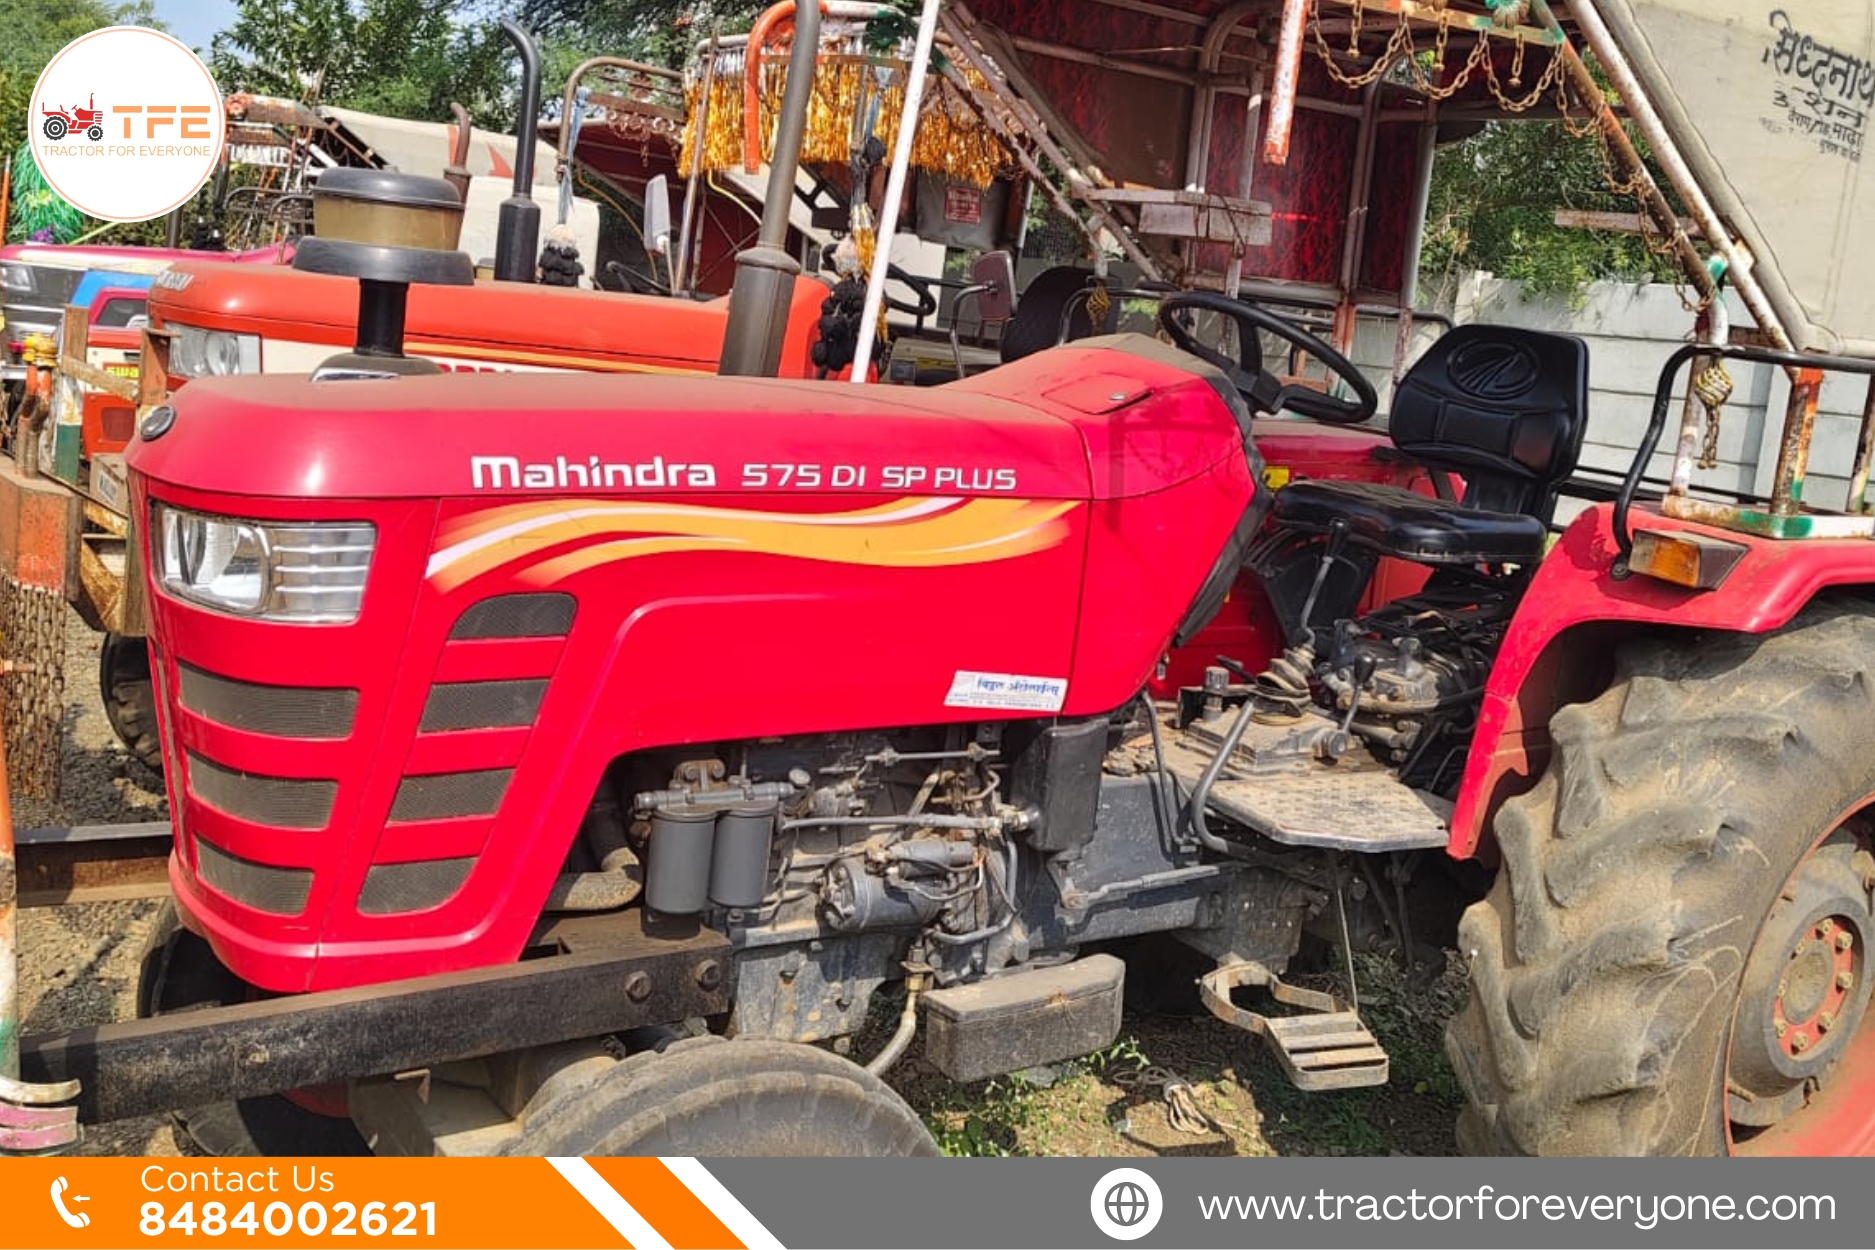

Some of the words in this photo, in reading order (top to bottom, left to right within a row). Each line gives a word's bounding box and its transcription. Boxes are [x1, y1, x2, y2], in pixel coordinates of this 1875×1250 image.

[471, 456, 716, 488] Mahindra
[741, 463, 821, 487] 575
[831, 465, 866, 487] DI
[881, 466, 926, 488] SP
[934, 467, 1016, 490] PLUS
